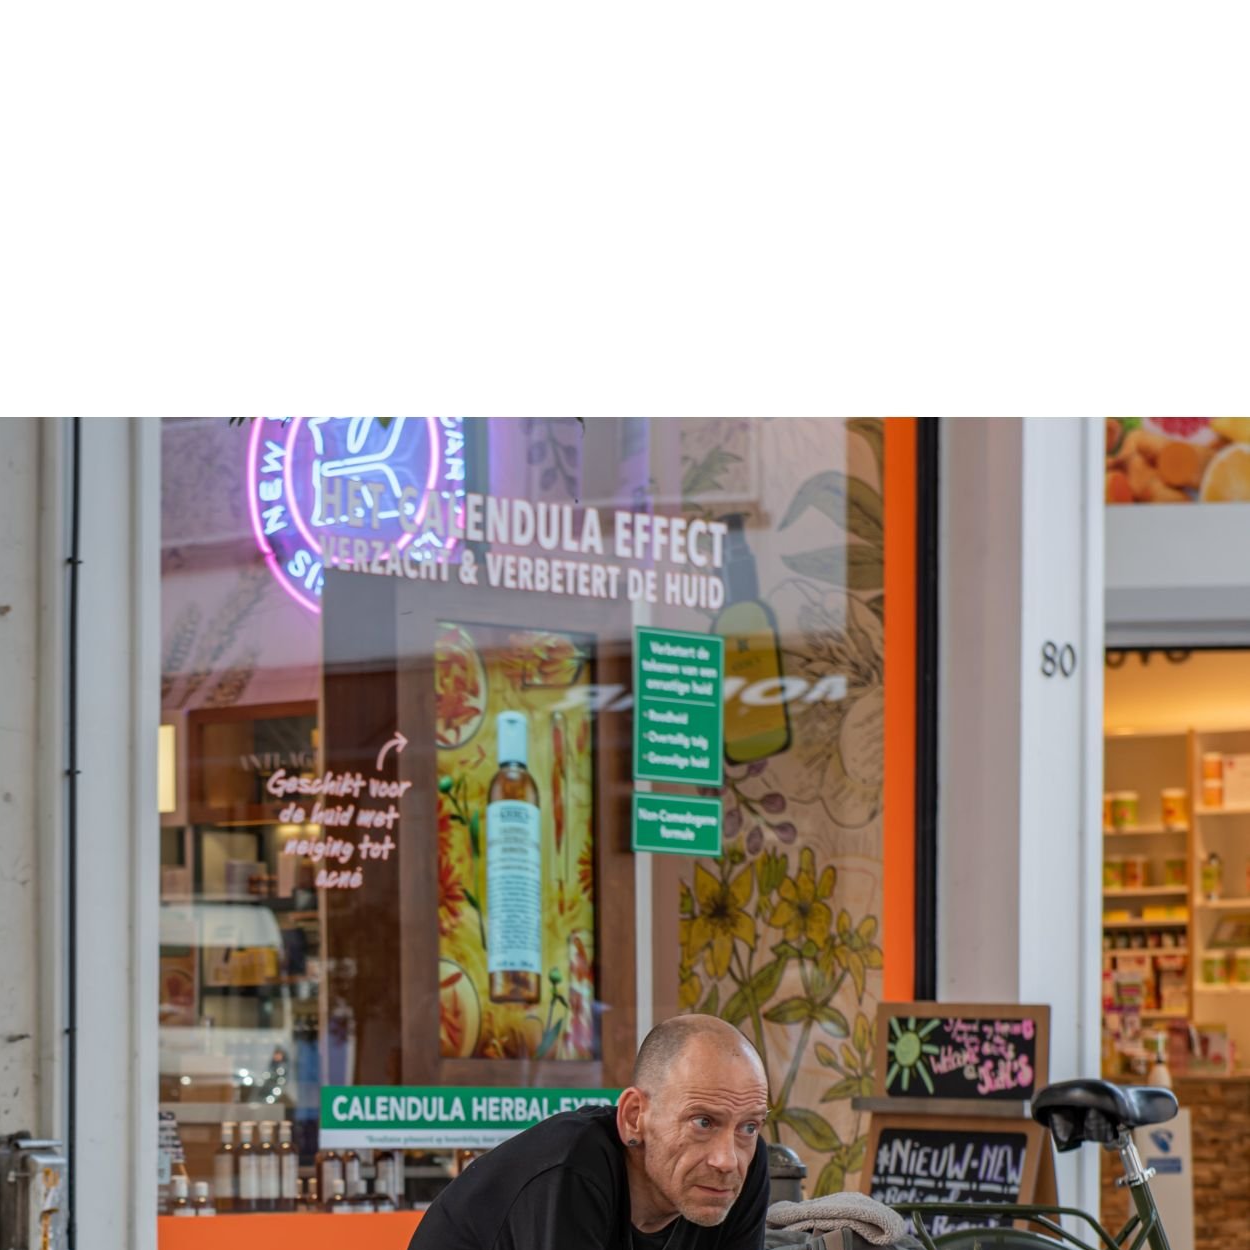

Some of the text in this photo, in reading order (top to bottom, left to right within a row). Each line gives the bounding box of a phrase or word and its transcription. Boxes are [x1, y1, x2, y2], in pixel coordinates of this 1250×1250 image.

[259, 440, 287, 535] NEW
[320, 476, 728, 569] HET CALENDULA EFFECT
[317, 534, 726, 610] VERZACHT & VERBETERT DE HUID
[1040, 640, 1078, 679] 80
[240, 751, 319, 771] ANTI-AG
[267, 768, 413, 798] Geschikt voor
[279, 801, 400, 829] de huid met
[284, 834, 396, 863] neiging tot
[332, 1095, 465, 1122] CALENDULA
